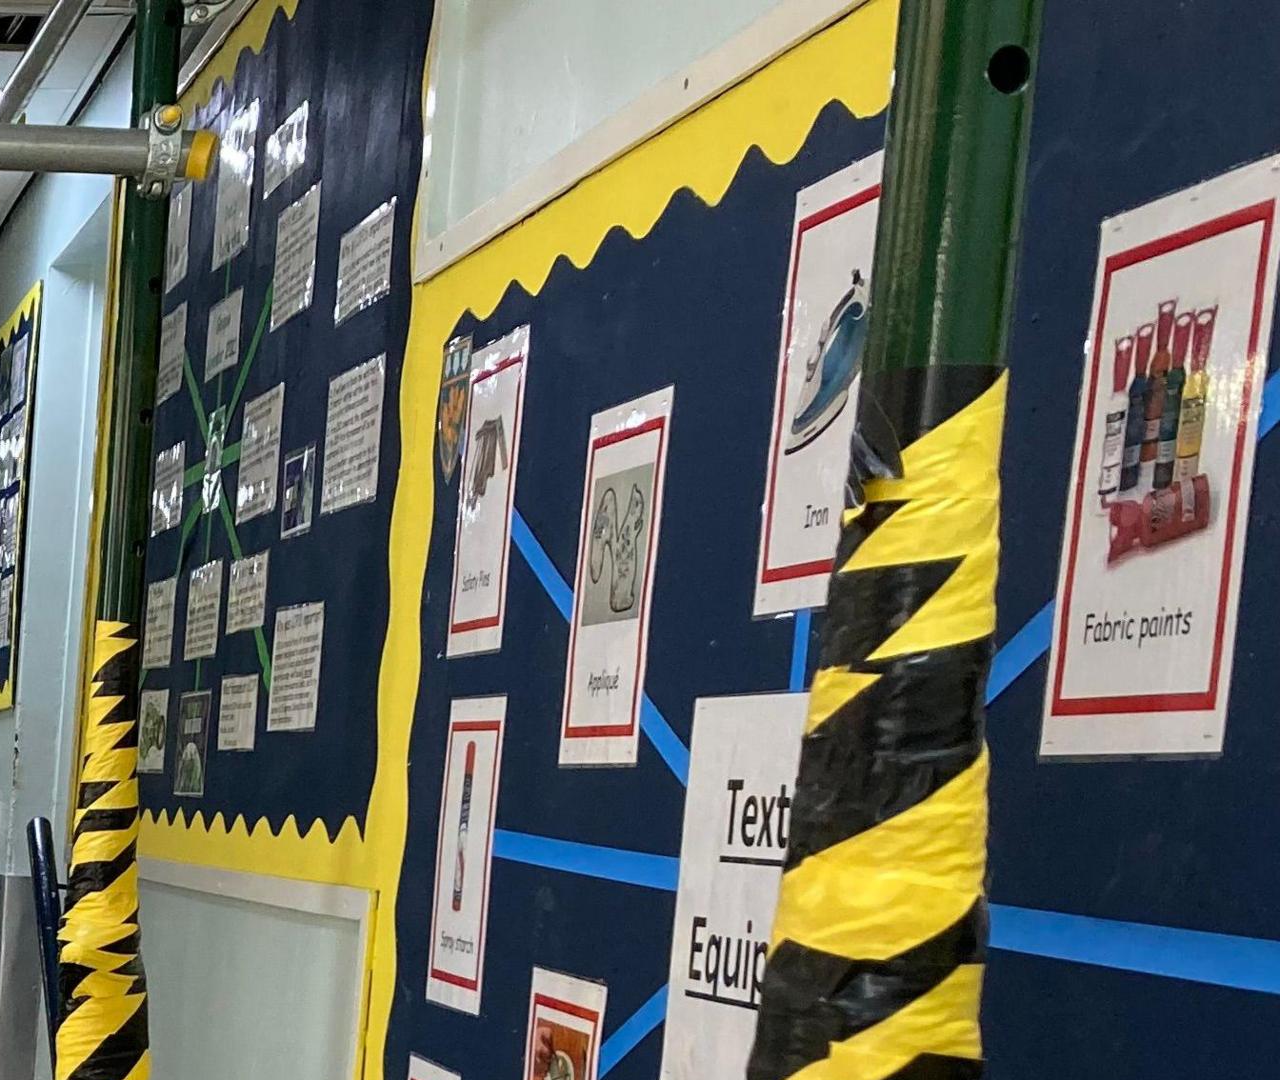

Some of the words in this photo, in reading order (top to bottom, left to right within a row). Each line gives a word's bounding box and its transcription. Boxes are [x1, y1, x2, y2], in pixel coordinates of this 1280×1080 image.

[804, 504, 829, 529] Iron
[1083, 611, 1135, 644] Fabric
[1138, 606, 1193, 648] paints
[587, 665, 620, 698] Appliqué
